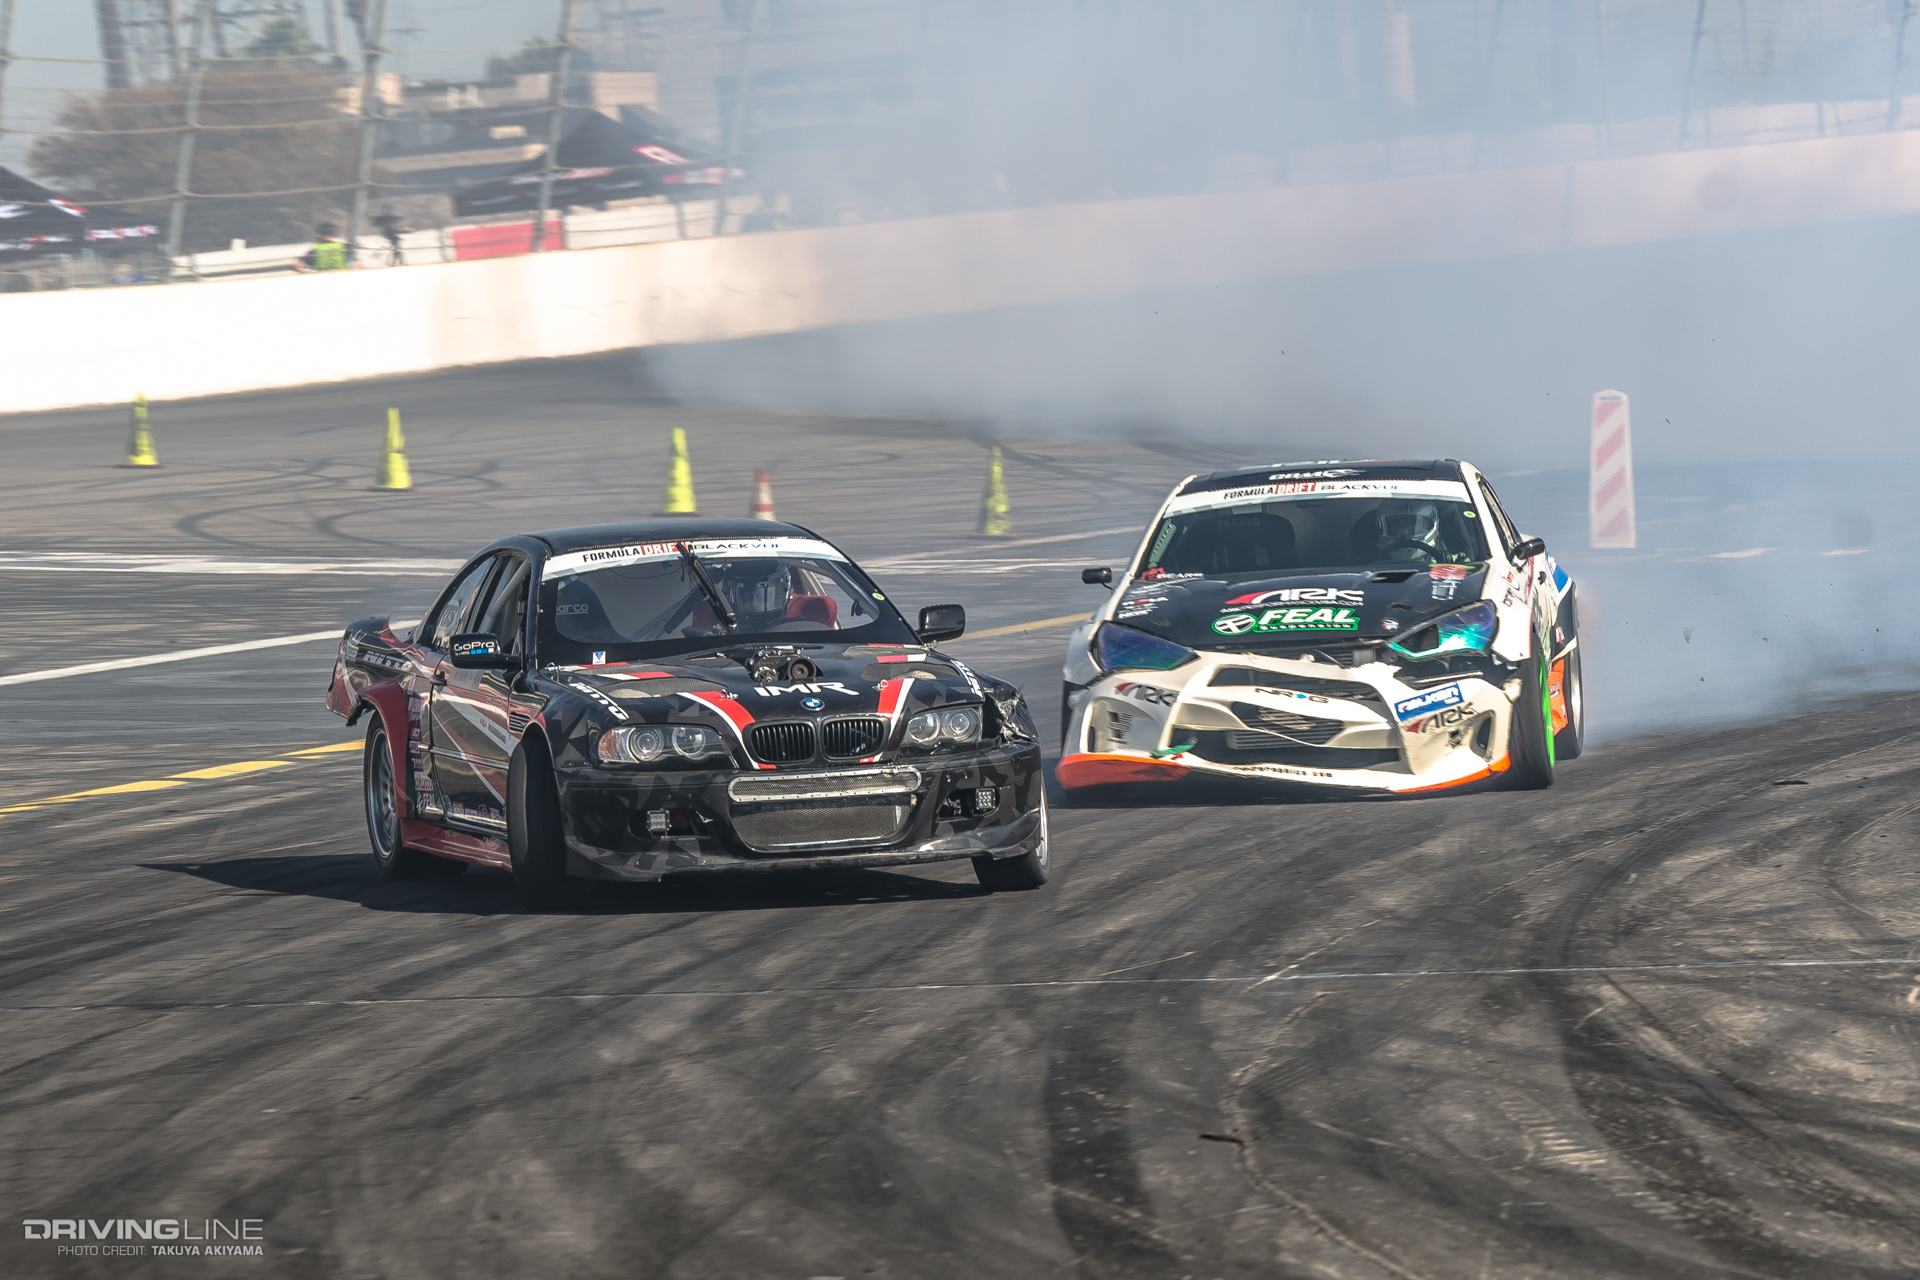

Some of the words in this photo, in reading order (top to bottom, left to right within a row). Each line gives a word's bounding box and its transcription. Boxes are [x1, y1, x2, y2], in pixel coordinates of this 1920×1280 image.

[1223, 486, 1274, 500] FORMULA
[1276, 482, 1316, 495] DRIFT
[582, 547, 641, 563] FORMULA
[1223, 587, 1364, 605] ARK
[1257, 608, 1357, 625] FEAL
[453, 641, 495, 652] GoPro
[753, 681, 860, 697] IMR
[1406, 702, 1475, 734] ARK
